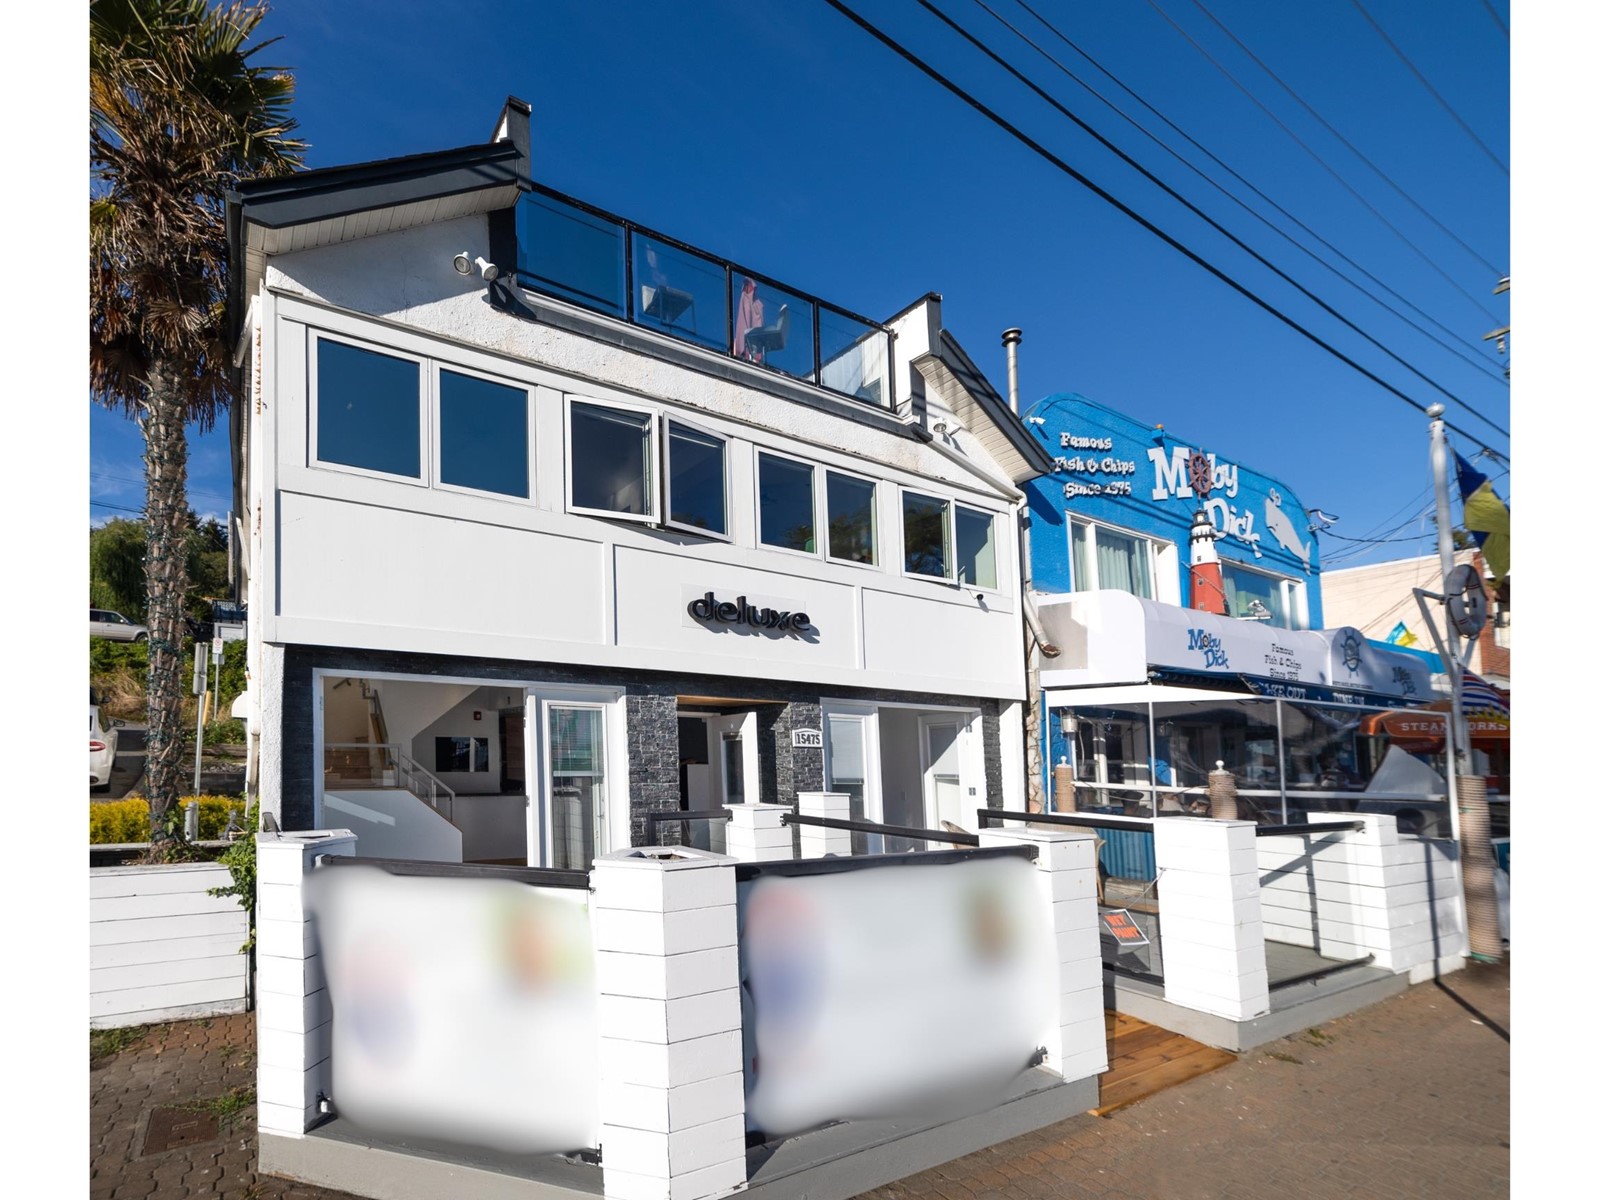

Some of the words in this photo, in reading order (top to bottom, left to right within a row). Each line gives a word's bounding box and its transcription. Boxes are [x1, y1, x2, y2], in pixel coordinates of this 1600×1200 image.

[1060, 432, 1112, 450] Famous
[1055, 456, 1085, 472] Fish
[1087, 459, 1098, 473] &
[1101, 457, 1136, 475] Chips
[1063, 482, 1101, 498] Since
[1104, 481, 1131, 495] 1975
[1203, 497, 1262, 559] Dick
[687, 591, 811, 631] deluxe
[1188, 629, 1221, 652] Moby
[1204, 648, 1229, 669] Dick
[796, 733, 821, 745] 15475
